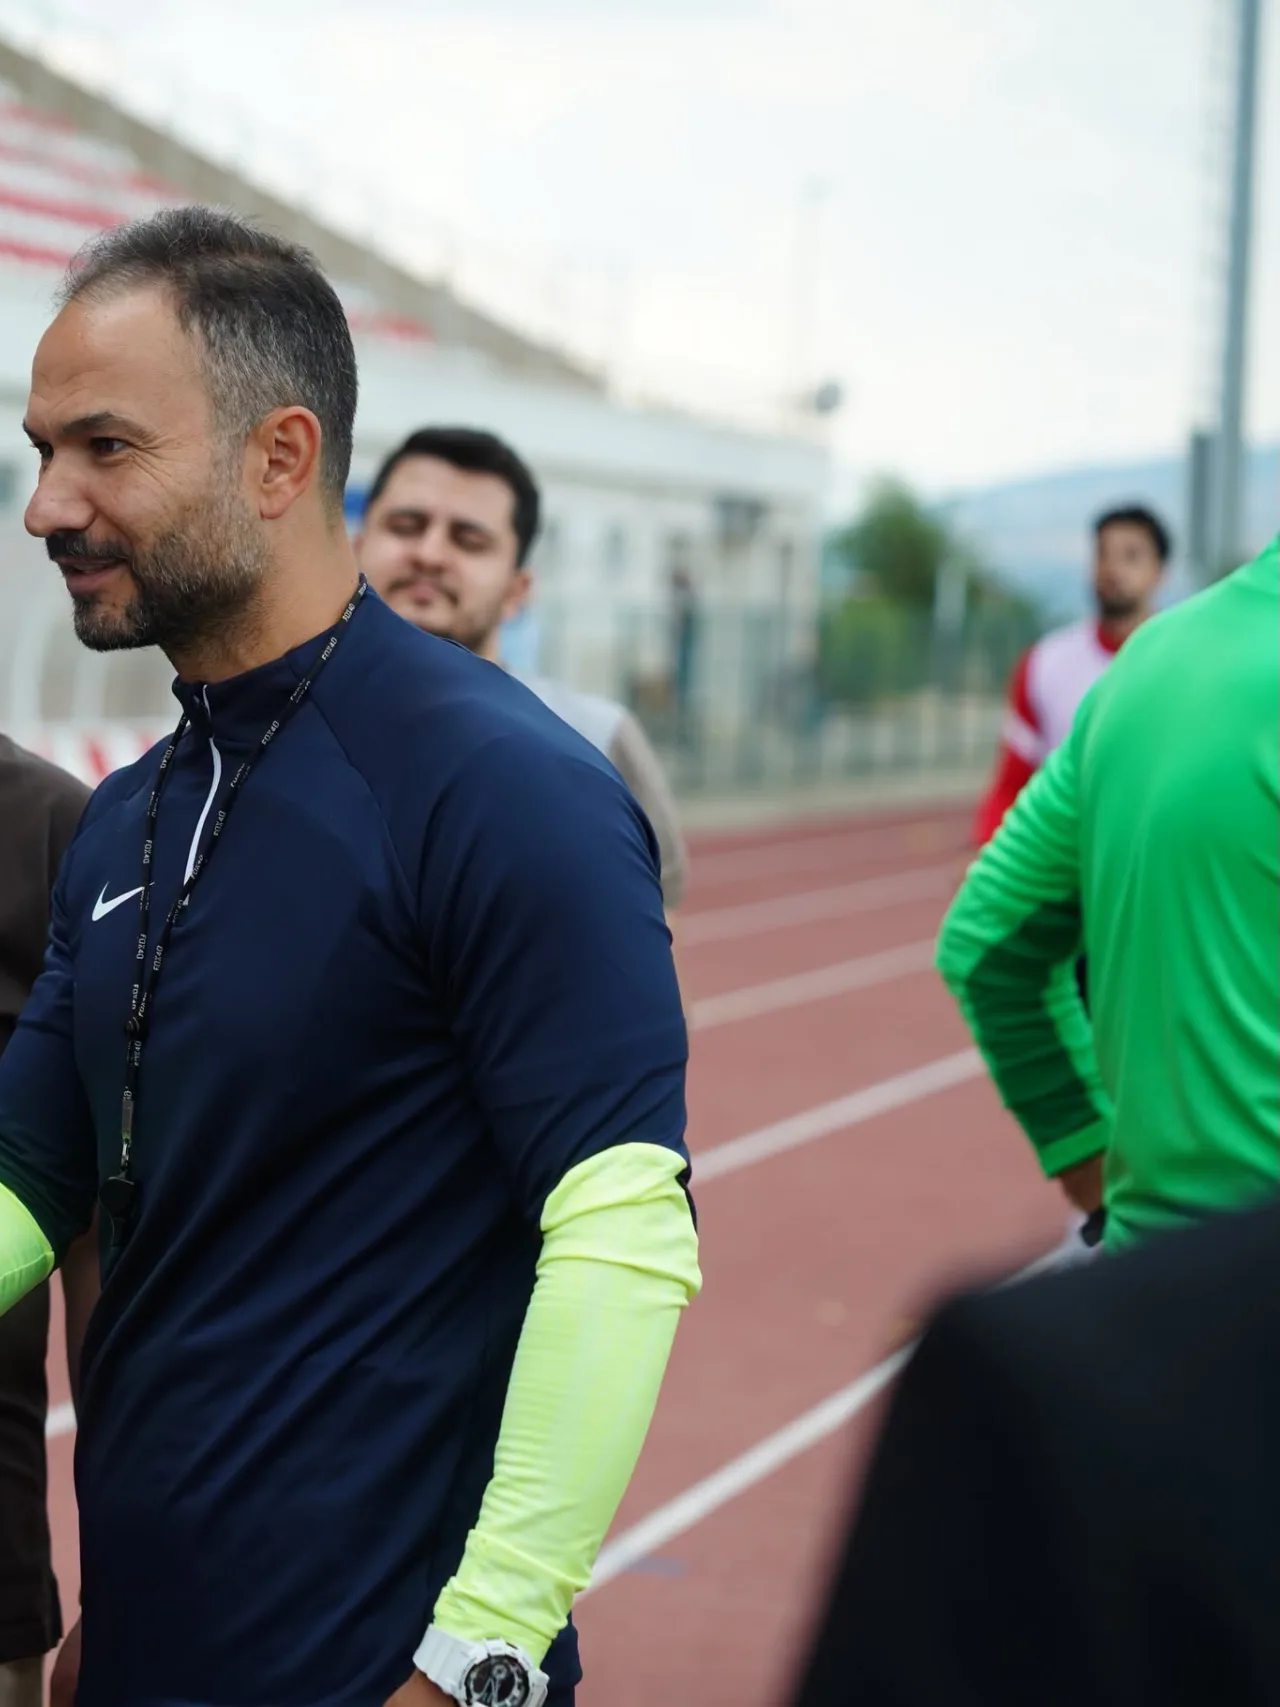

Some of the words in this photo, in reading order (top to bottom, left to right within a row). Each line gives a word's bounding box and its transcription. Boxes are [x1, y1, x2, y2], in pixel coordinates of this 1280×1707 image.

[322, 637, 337, 660] FOX40
[262, 720, 280, 745] FOX40
[160, 745, 174, 769] FOX40
[214, 811, 226, 836] FOX40
[143, 840, 152, 864] FOX40
[137, 934, 147, 960] FOX40
[153, 945, 163, 971] FOX40
